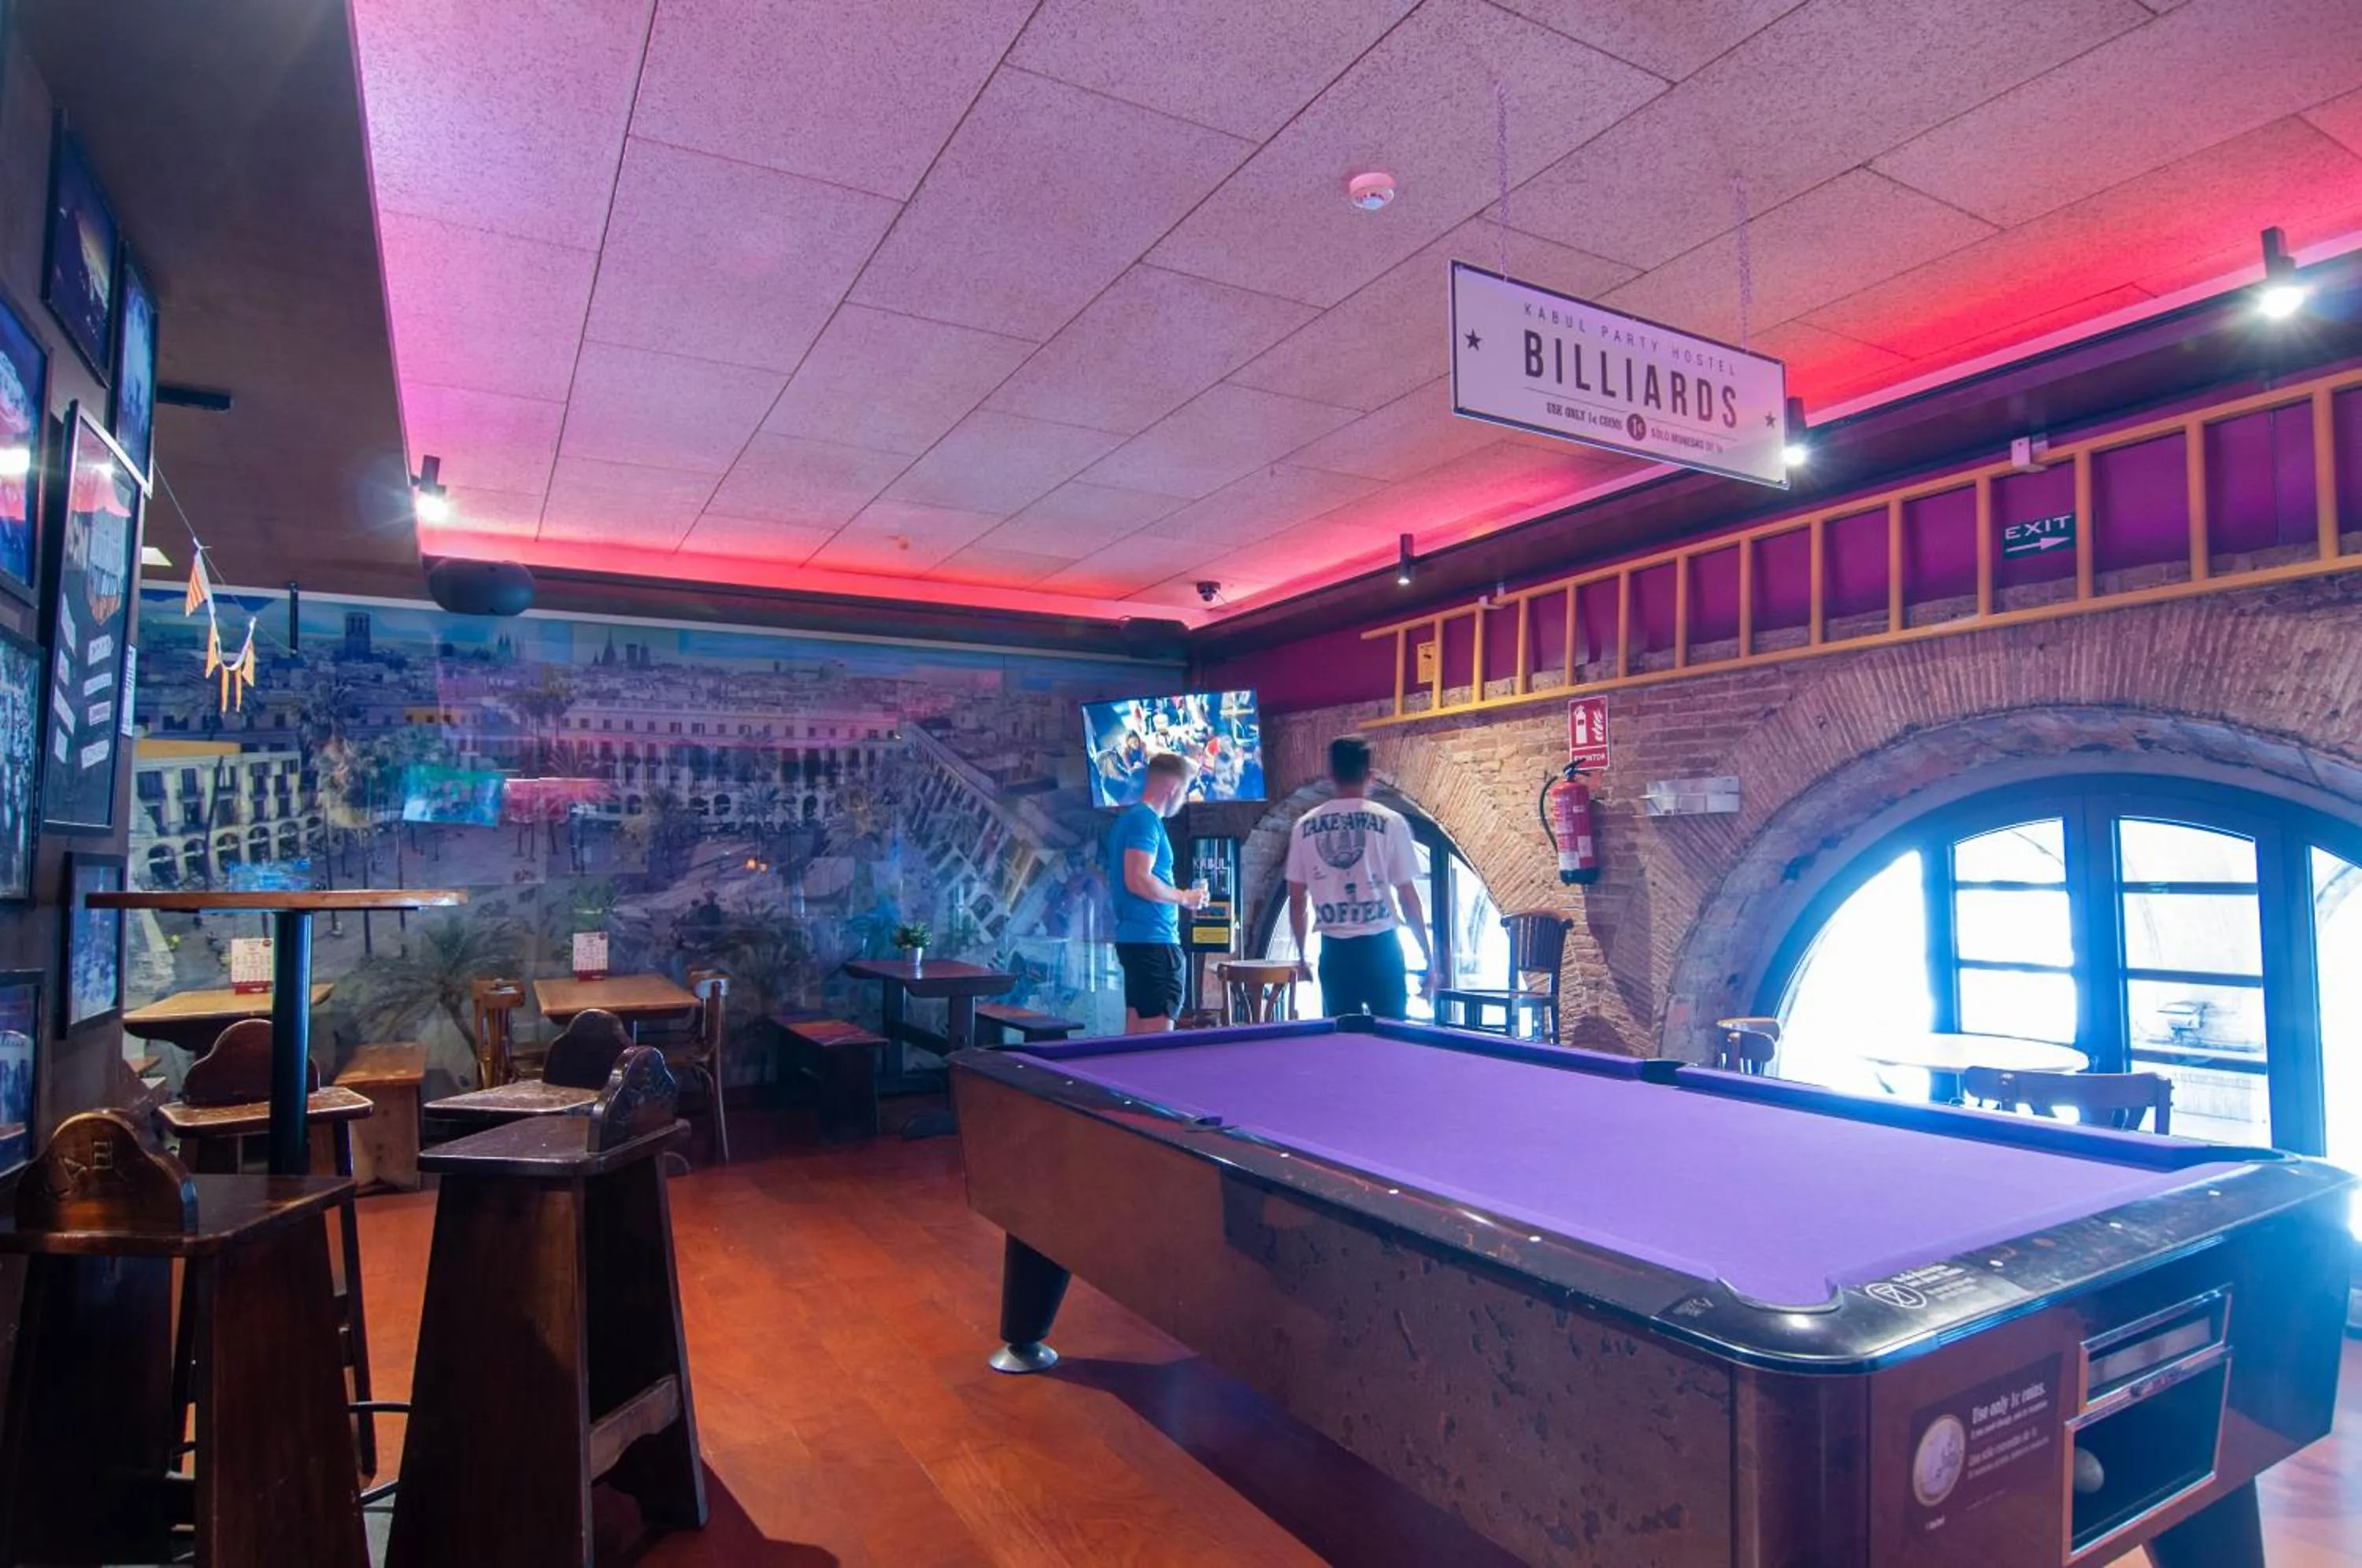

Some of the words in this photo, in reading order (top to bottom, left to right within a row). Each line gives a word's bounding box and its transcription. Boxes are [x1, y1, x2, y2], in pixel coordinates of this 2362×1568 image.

[1524, 302, 1586, 332] KABUL
[1601, 325, 1659, 352] PARTY
[1672, 346, 1736, 376] HOSTEL
[1524, 328, 1737, 429] BILLIARDS
[1546, 401, 1563, 416] USE
[1564, 406, 1586, 421] ONLY
[1599, 415, 1623, 431] COINS
[2005, 514, 2072, 540] EXIT
[1303, 812, 1340, 838] TAKE
[1342, 812, 1389, 834] AWAY
